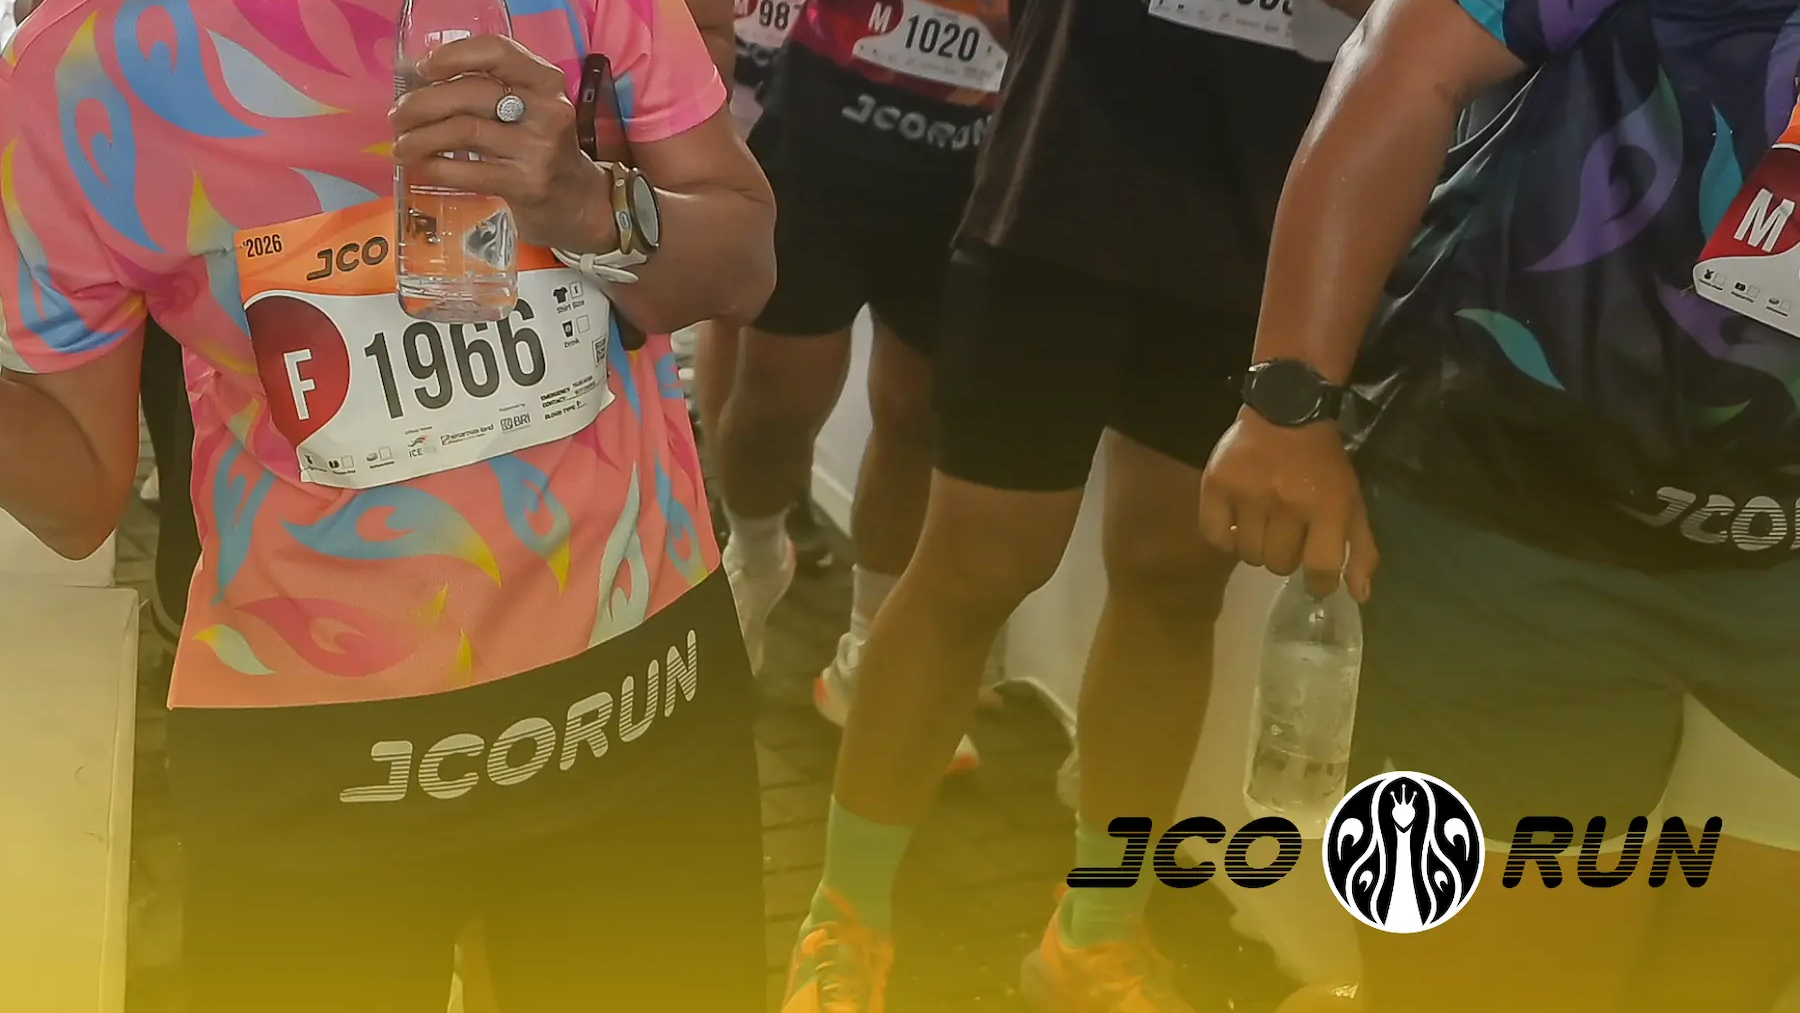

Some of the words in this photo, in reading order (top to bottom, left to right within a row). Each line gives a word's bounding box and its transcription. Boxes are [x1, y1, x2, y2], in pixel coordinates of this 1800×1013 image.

[867, 1, 893, 33] M
[905, 14, 980, 62] 1020
[247, 234, 283, 258] 2026
[1733, 188, 1796, 253] M
[306, 236, 389, 281] JCO
[283, 348, 316, 420] F
[364, 298, 546, 419] 1966
[514, 415, 531, 428] BRI
[1614, 486, 1800, 551] JCO
[339, 629, 697, 803] JCORUN
